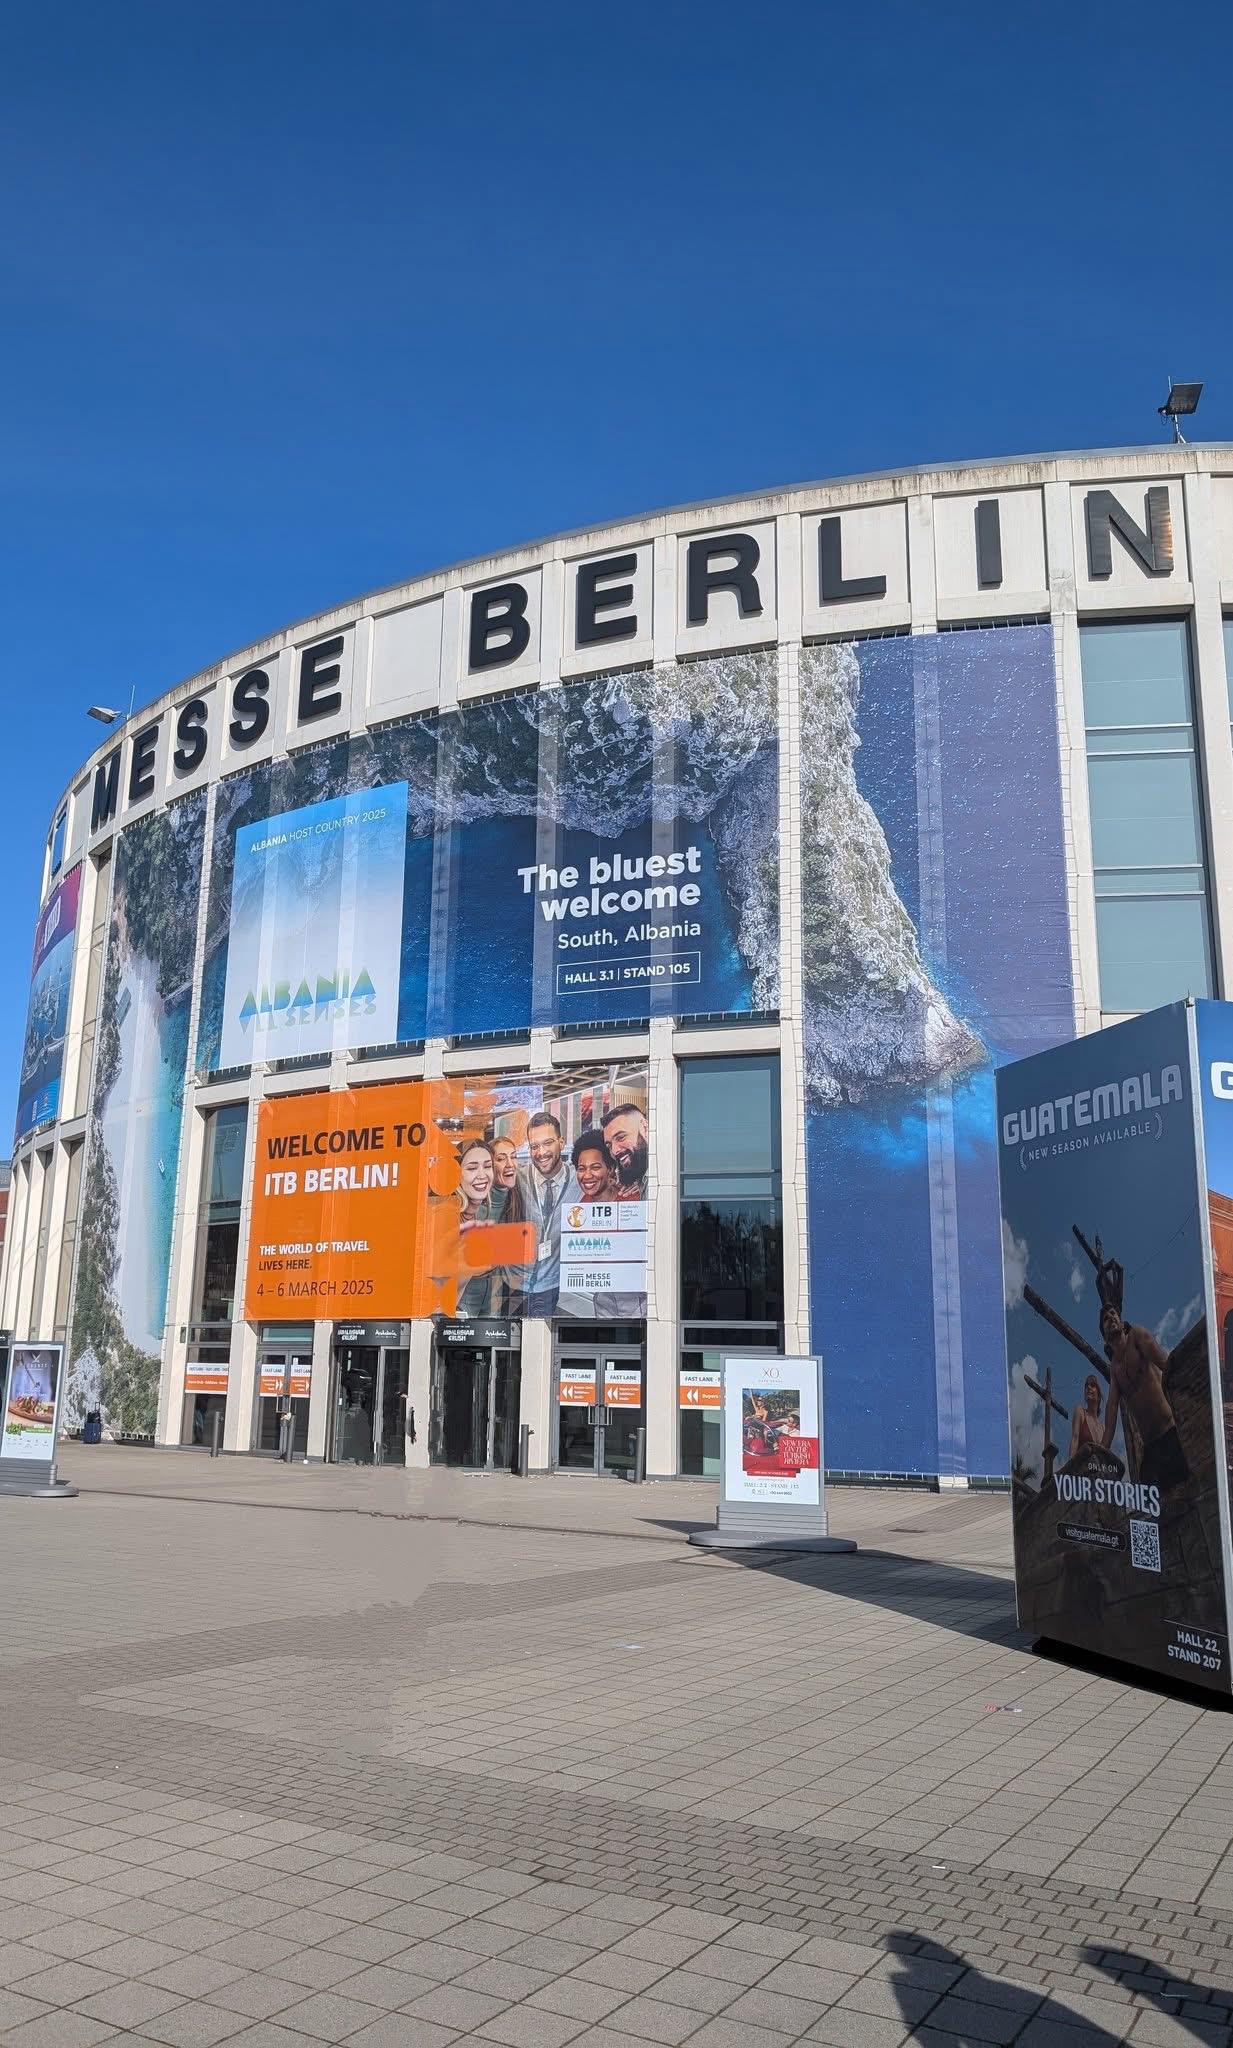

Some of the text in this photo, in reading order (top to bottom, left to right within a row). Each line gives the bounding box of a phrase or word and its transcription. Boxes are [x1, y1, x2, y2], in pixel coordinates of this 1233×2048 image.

[90, 486, 1174, 836] MESSE BERLIN
[250, 808, 386, 853] ALBANIA HOST COUNTRY 2025
[517, 846, 701, 894] The bluest
[541, 883, 701, 921] welcome
[557, 921, 701, 950] South, Albania
[564, 963, 691, 985] HALL 3.1 STAND 105
[239, 966, 377, 1018] ALBANIA
[1002, 1064, 1183, 1146] GUATEMALA
[267, 1122, 427, 1159] WELCOME TO
[1028, 1121, 1151, 1161] NEW SEASON AVAILABLE
[264, 1162, 399, 1197] ITB BERLIN!
[592, 1206, 612, 1218] ITB
[260, 1240, 370, 1256] THE WORLD OF TRAVEL
[258, 1258, 313, 1271] LIVES HERE.
[256, 1283, 264, 1297] 4
[277, 1282, 285, 1297] 6
[288, 1281, 337, 1297] MARCH
[341, 1280, 374, 1296] 2025
[783, 1452, 811, 1460] TURKISH
[1087, 1462, 1118, 1474] ONLY ON
[1054, 1473, 1161, 1518] YOUR STORIES
[1065, 1528, 1119, 1548] visitguatemala.gt
[1177, 1630, 1222, 1655] HALL 22,
[1167, 1645, 1222, 1671] STAND 207
